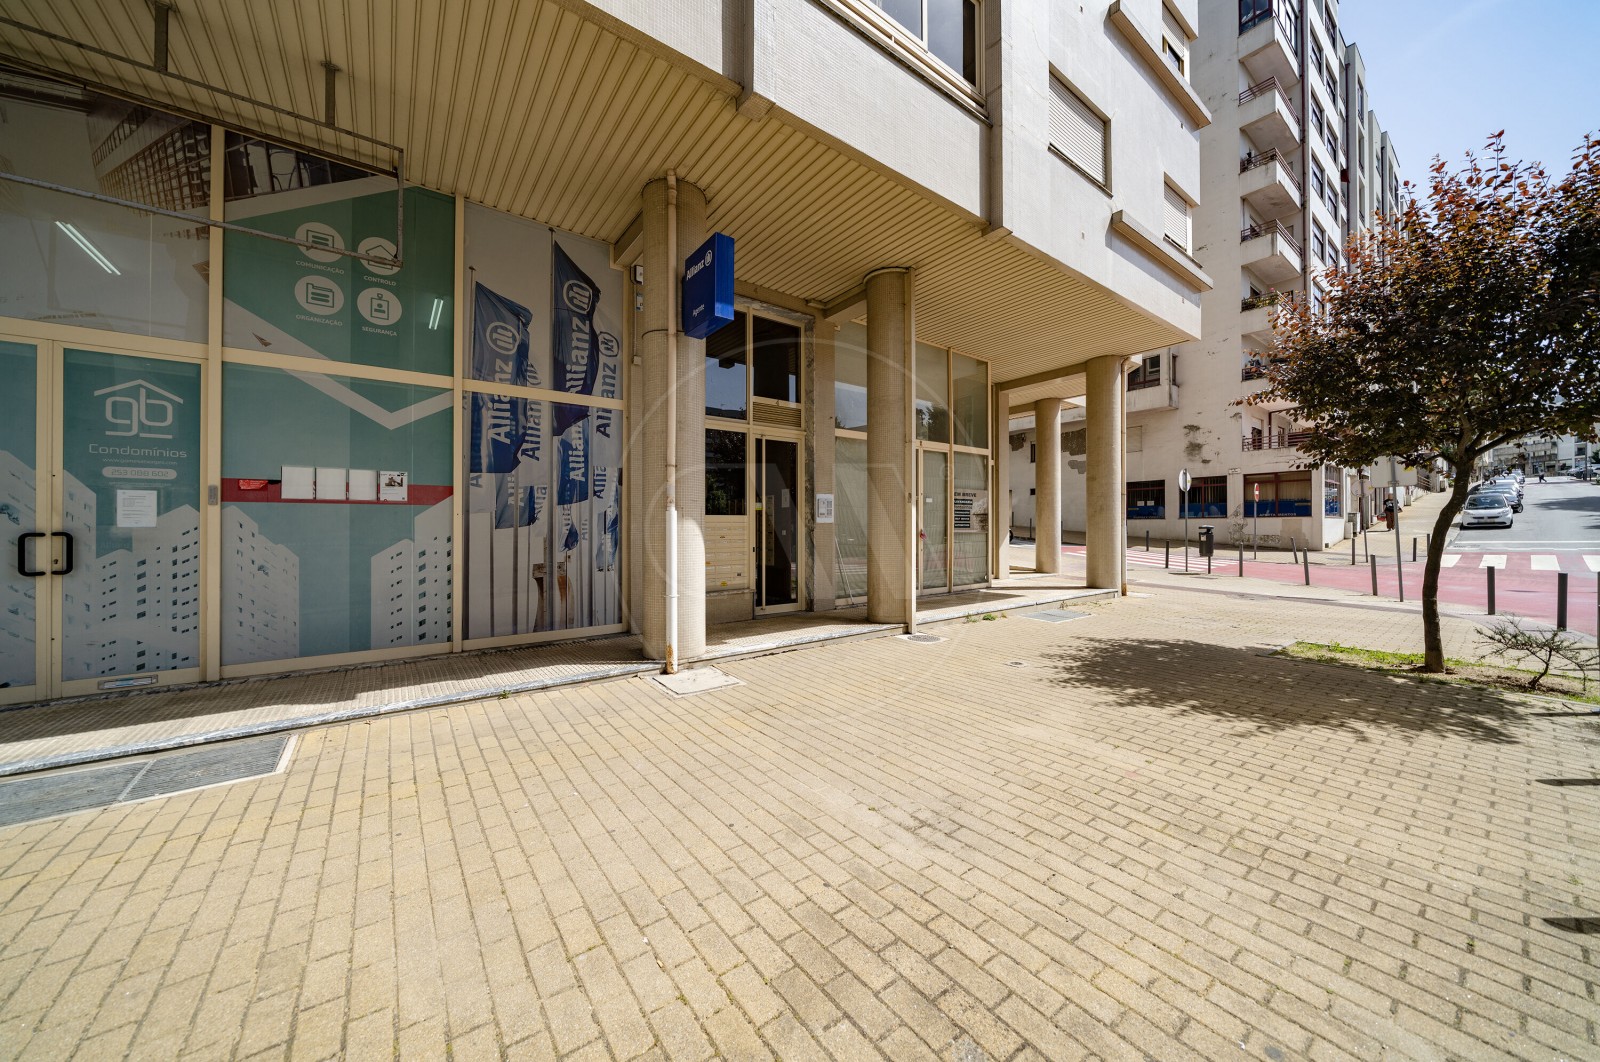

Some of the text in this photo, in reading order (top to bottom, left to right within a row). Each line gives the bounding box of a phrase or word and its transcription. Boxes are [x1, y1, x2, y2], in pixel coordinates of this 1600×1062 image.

[295, 260, 345, 275] COMUNICAÇÃO
[687, 259, 705, 281] Allianz
[363, 275, 397, 287] CONTROLO
[692, 303, 705, 318] Agente
[295, 314, 343, 327] ORGANIZAÇÃO
[361, 325, 398, 337] SEGURANÇA
[595, 361, 617, 439] Allanz
[105, 387, 173, 437] gb
[88, 443, 188, 458] Condomínios
[111, 468, 128, 476] 253
